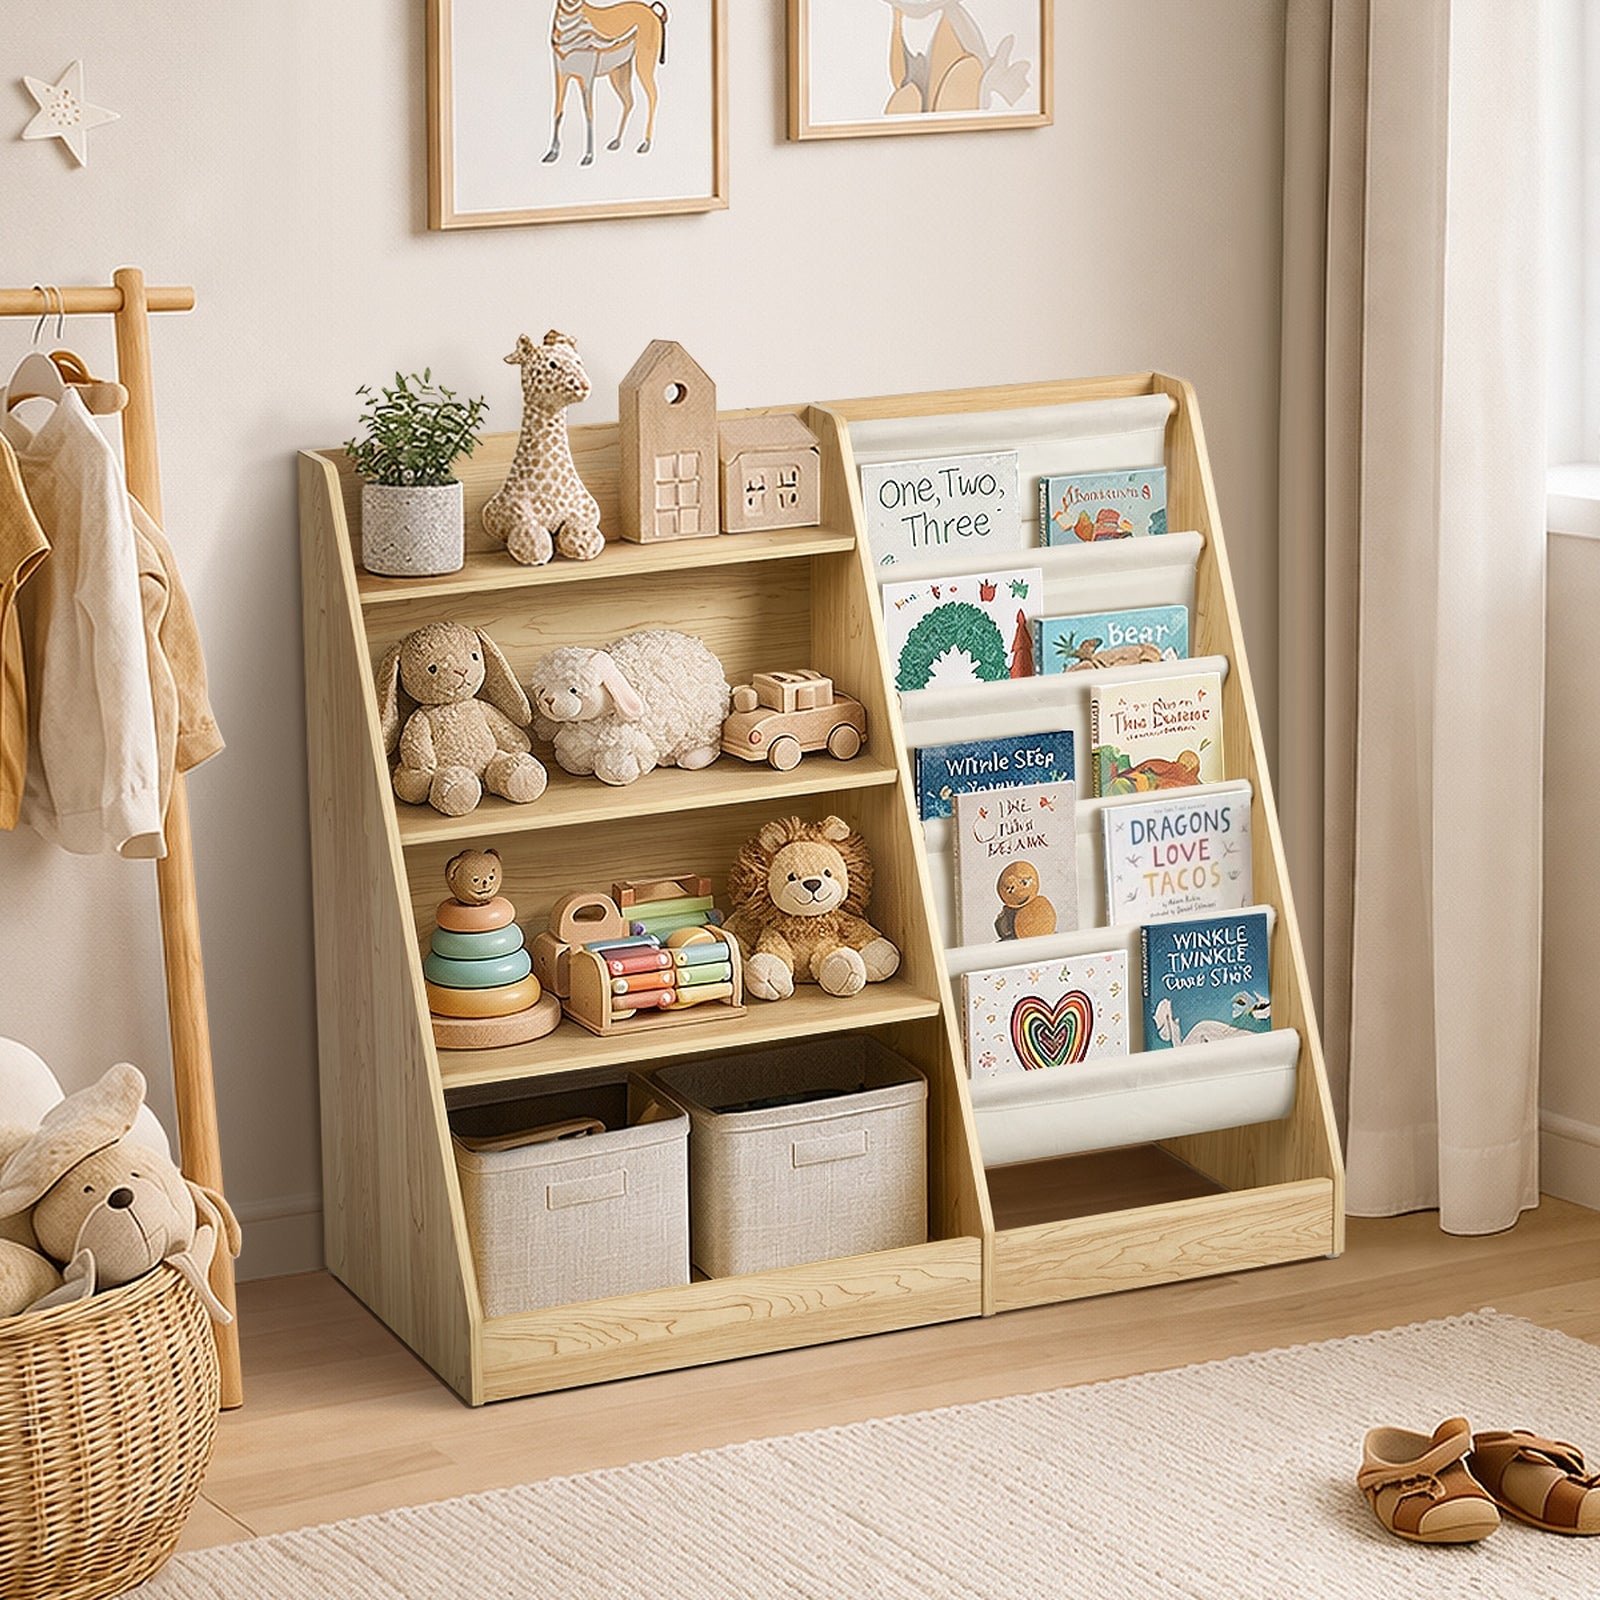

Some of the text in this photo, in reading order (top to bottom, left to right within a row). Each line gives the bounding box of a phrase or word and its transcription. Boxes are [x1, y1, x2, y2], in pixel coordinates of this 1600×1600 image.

[879, 467, 1005, 510] One, Two,
[900, 511, 991, 548] Three
[1130, 807, 1231, 845] DRAGONS
[1152, 838, 1211, 868] LOVE
[1142, 861, 1222, 898] TACOS
[1172, 925, 1248, 951] WINKLE
